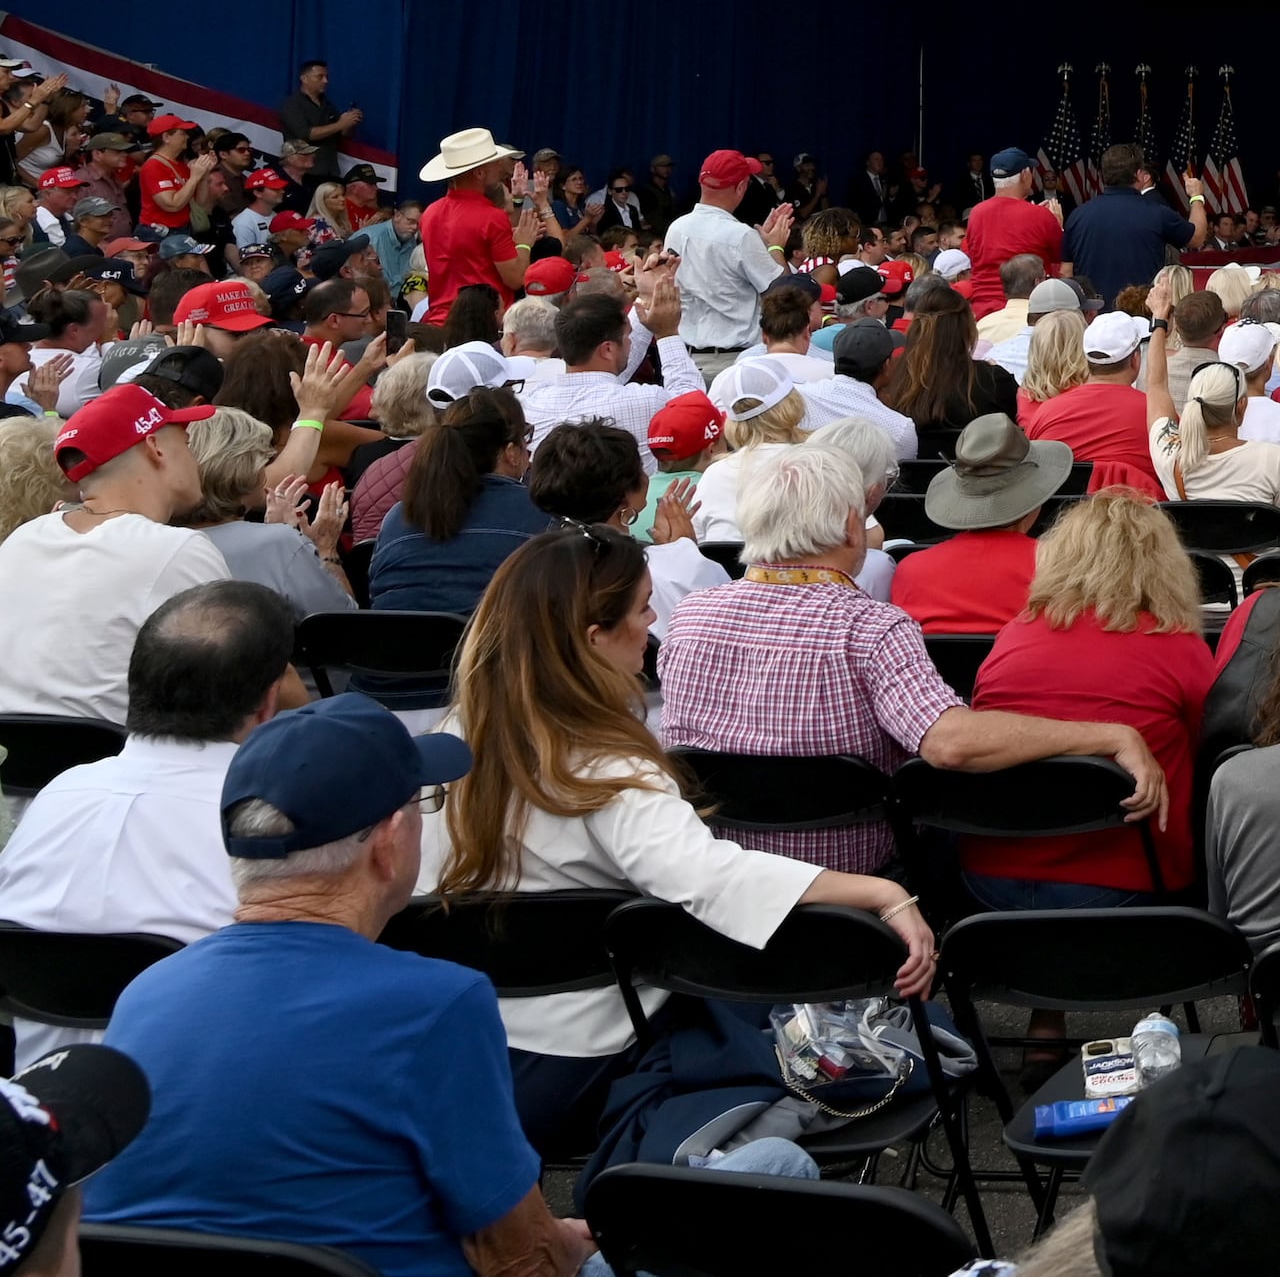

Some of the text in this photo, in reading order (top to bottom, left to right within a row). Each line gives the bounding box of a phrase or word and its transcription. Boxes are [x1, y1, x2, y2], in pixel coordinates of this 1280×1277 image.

[101, 271, 121, 279] 45-47
[216, 291, 240, 303] MAKE
[224, 301, 248, 313] GREAT
[135, 408, 164, 434] 45-47
[704, 420, 719, 439] 45
[1089, 1057, 1135, 1070] JACKSON
